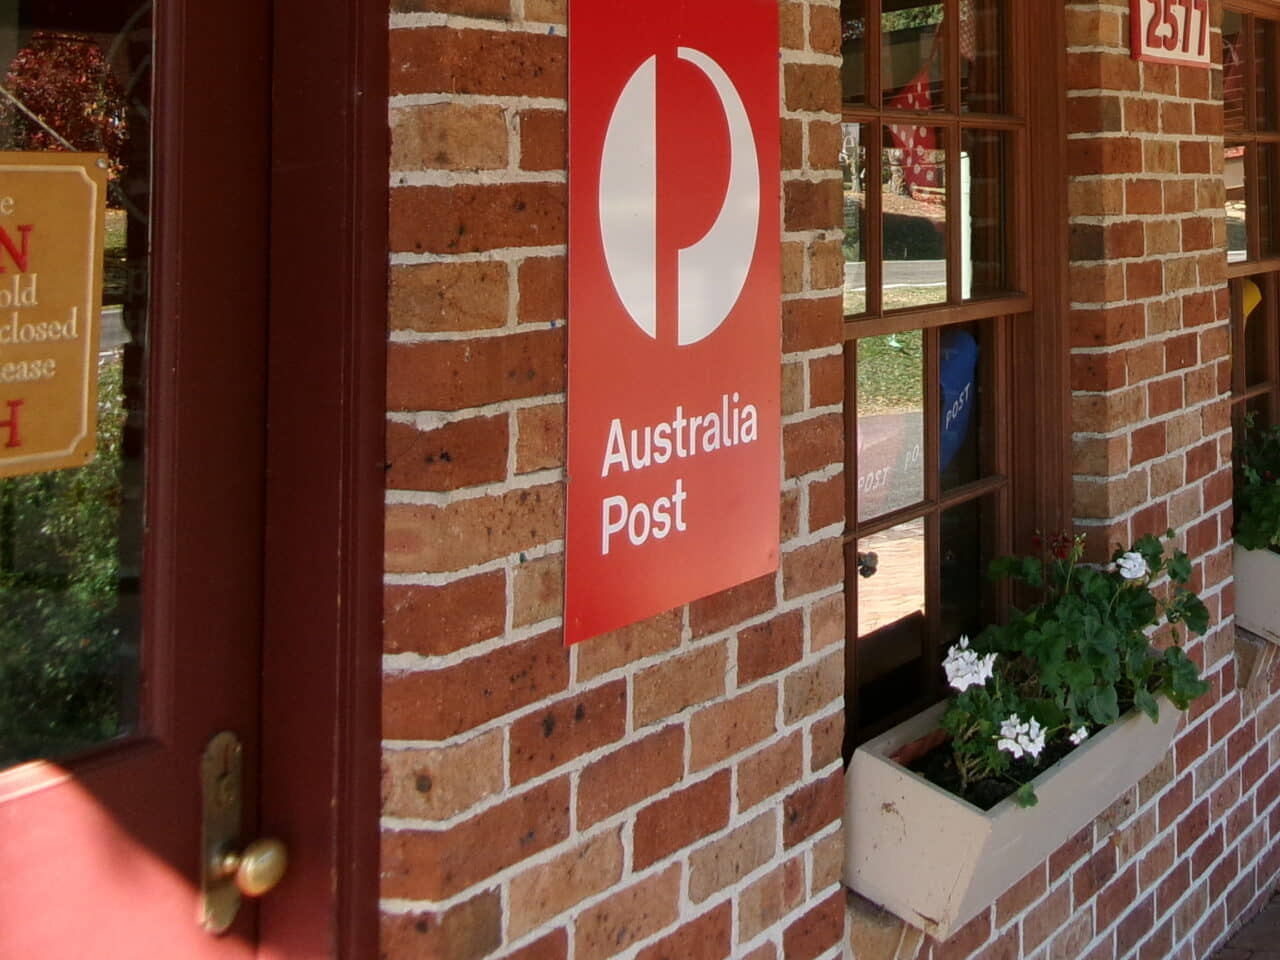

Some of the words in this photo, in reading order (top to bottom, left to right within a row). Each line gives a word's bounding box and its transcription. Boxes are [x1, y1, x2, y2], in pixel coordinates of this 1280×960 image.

[0, 357, 56, 384] ease
[601, 392, 757, 478] Australia
[945, 382, 971, 431] POST
[602, 479, 686, 555] Post
